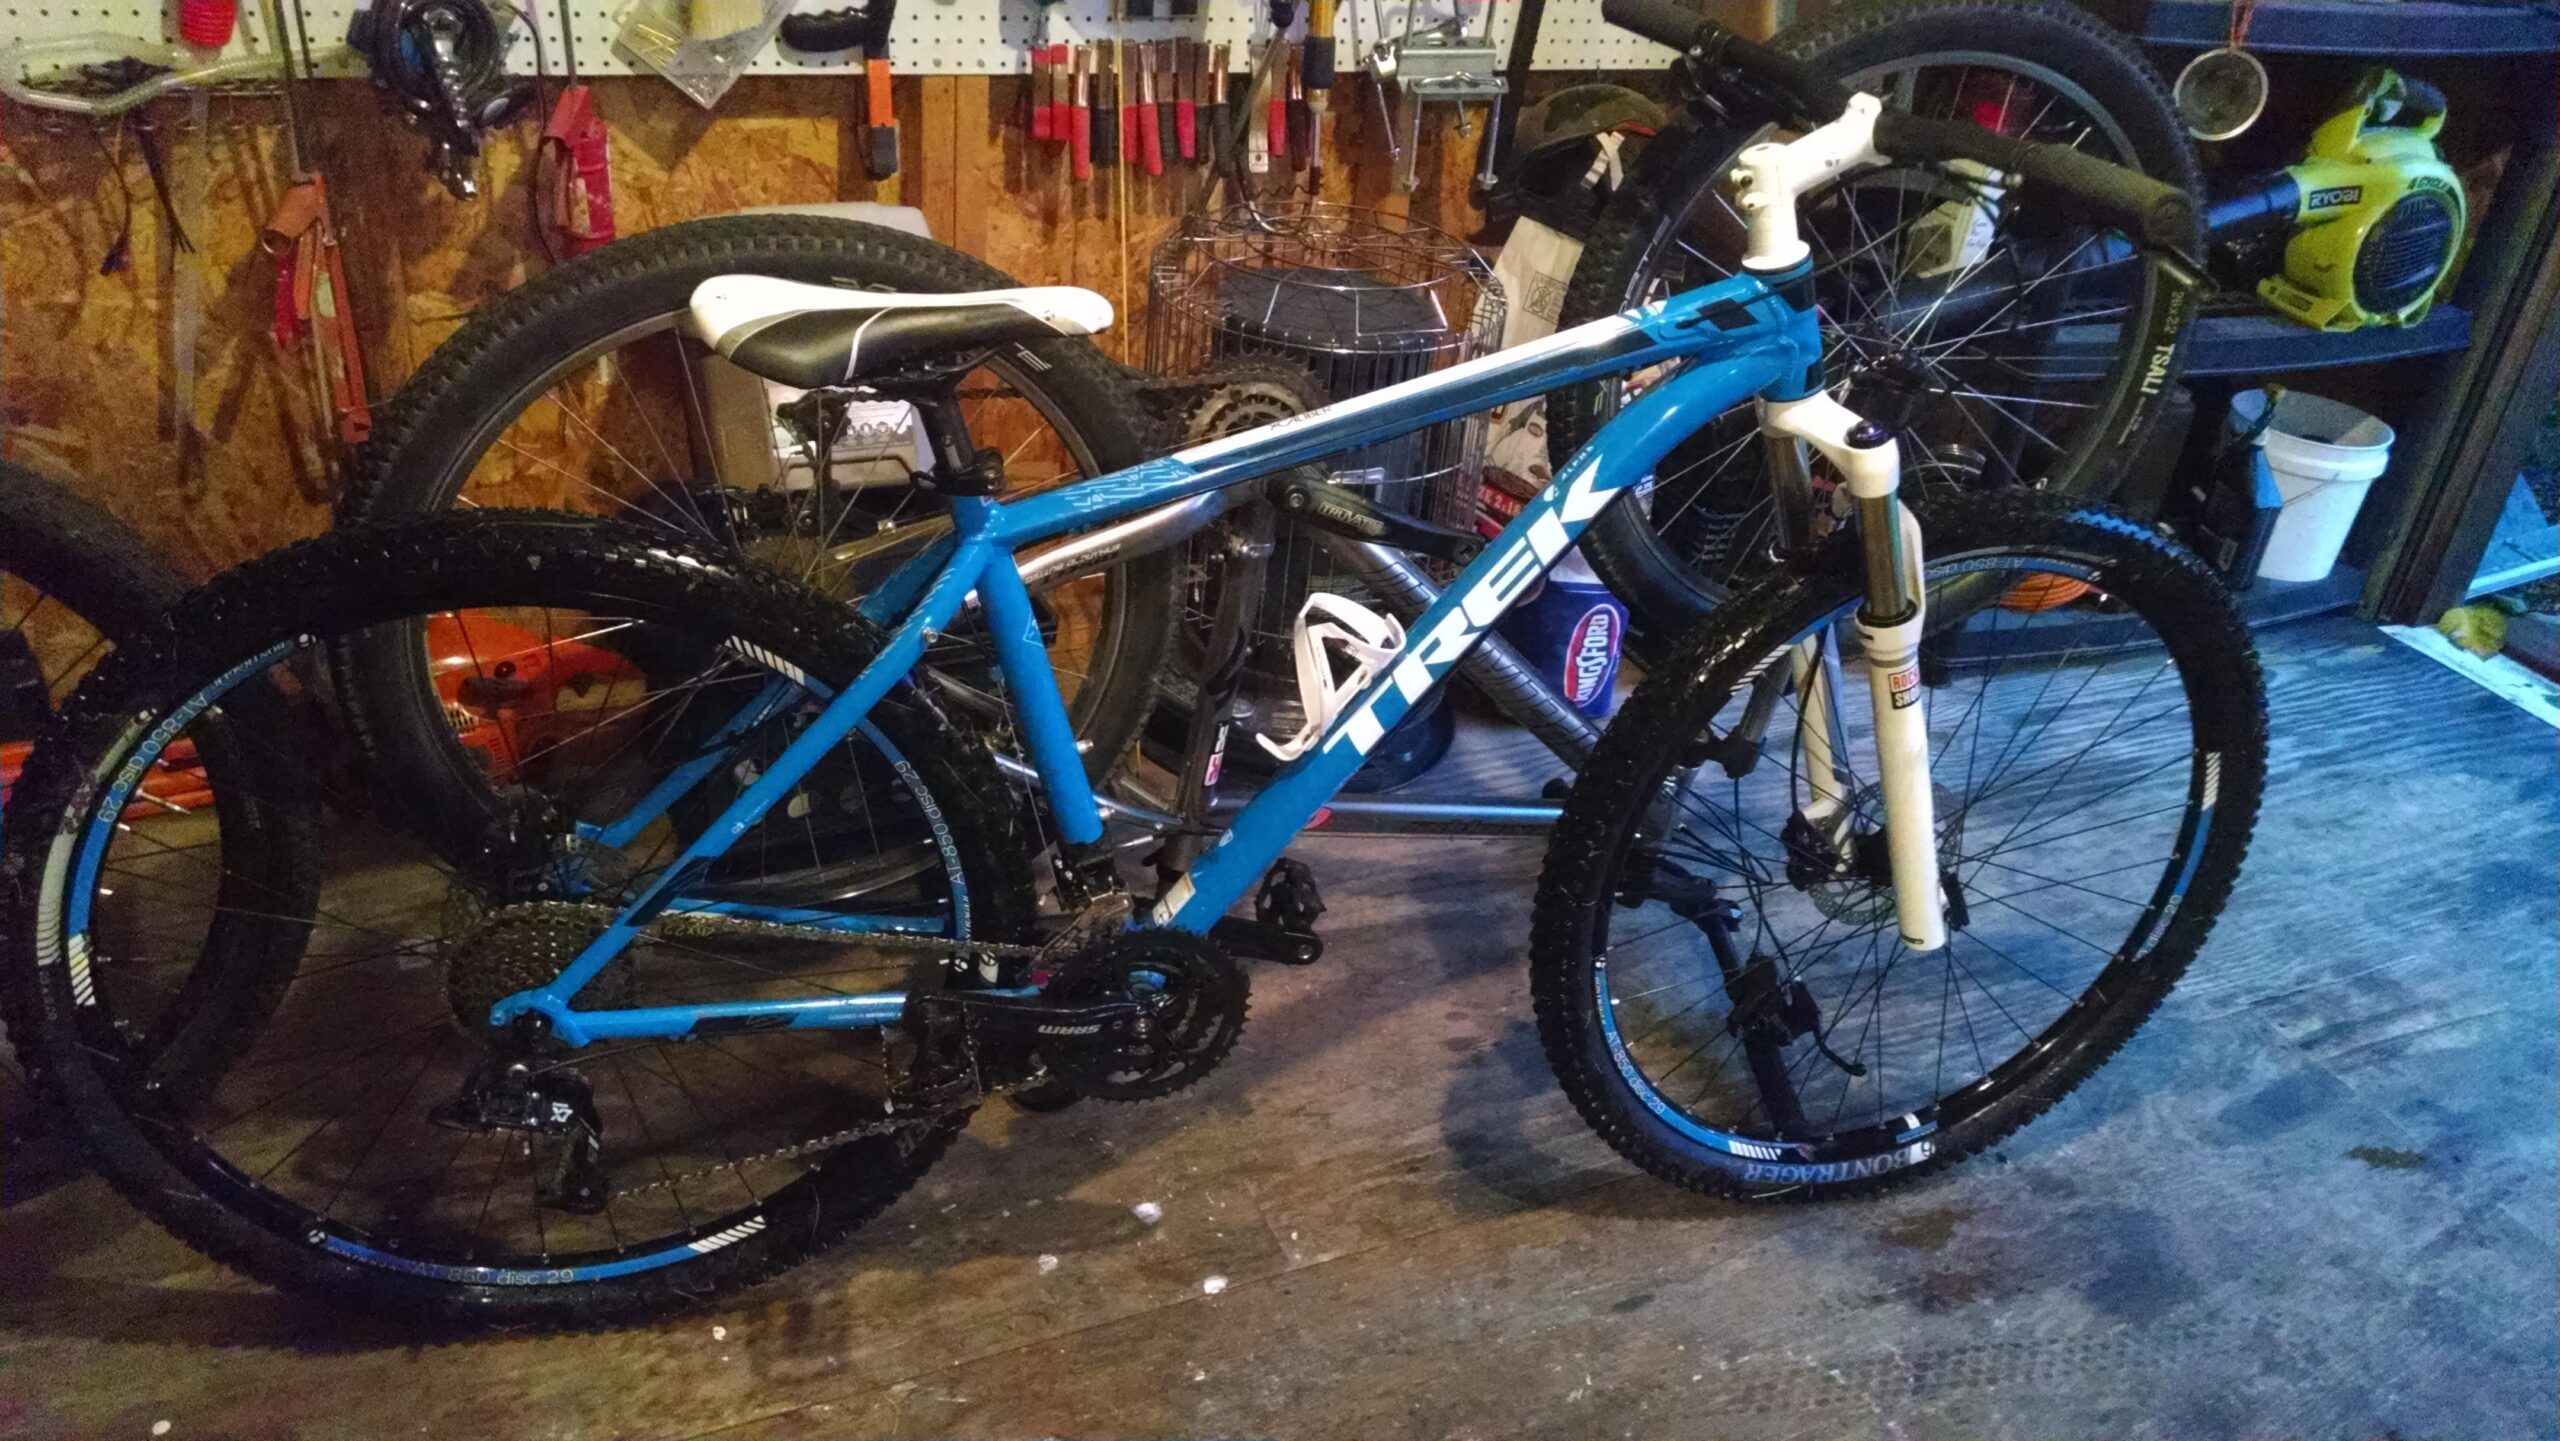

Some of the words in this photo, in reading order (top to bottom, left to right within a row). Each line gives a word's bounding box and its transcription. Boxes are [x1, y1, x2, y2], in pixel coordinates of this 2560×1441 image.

[2310, 189, 2360, 208] RYOBI
[2140, 343, 2176, 395] TSALI
[1322, 453, 1620, 757] TREK
[1572, 612, 1610, 702] KINGSFORD
[111, 755, 146, 793] disc
[894, 759, 921, 785] 29
[96, 795, 122, 823] 29
[914, 784, 943, 820] disc
[931, 822, 966, 886] AT-850
[1038, 1024, 1102, 1035] SRAM
[1628, 1076, 1653, 1102] disc
[1647, 1096, 1667, 1116] 29
[1743, 1149, 1912, 1185] BONTRAGER
[496, 1268, 539, 1286] disc
[547, 1268, 575, 1285] 29
